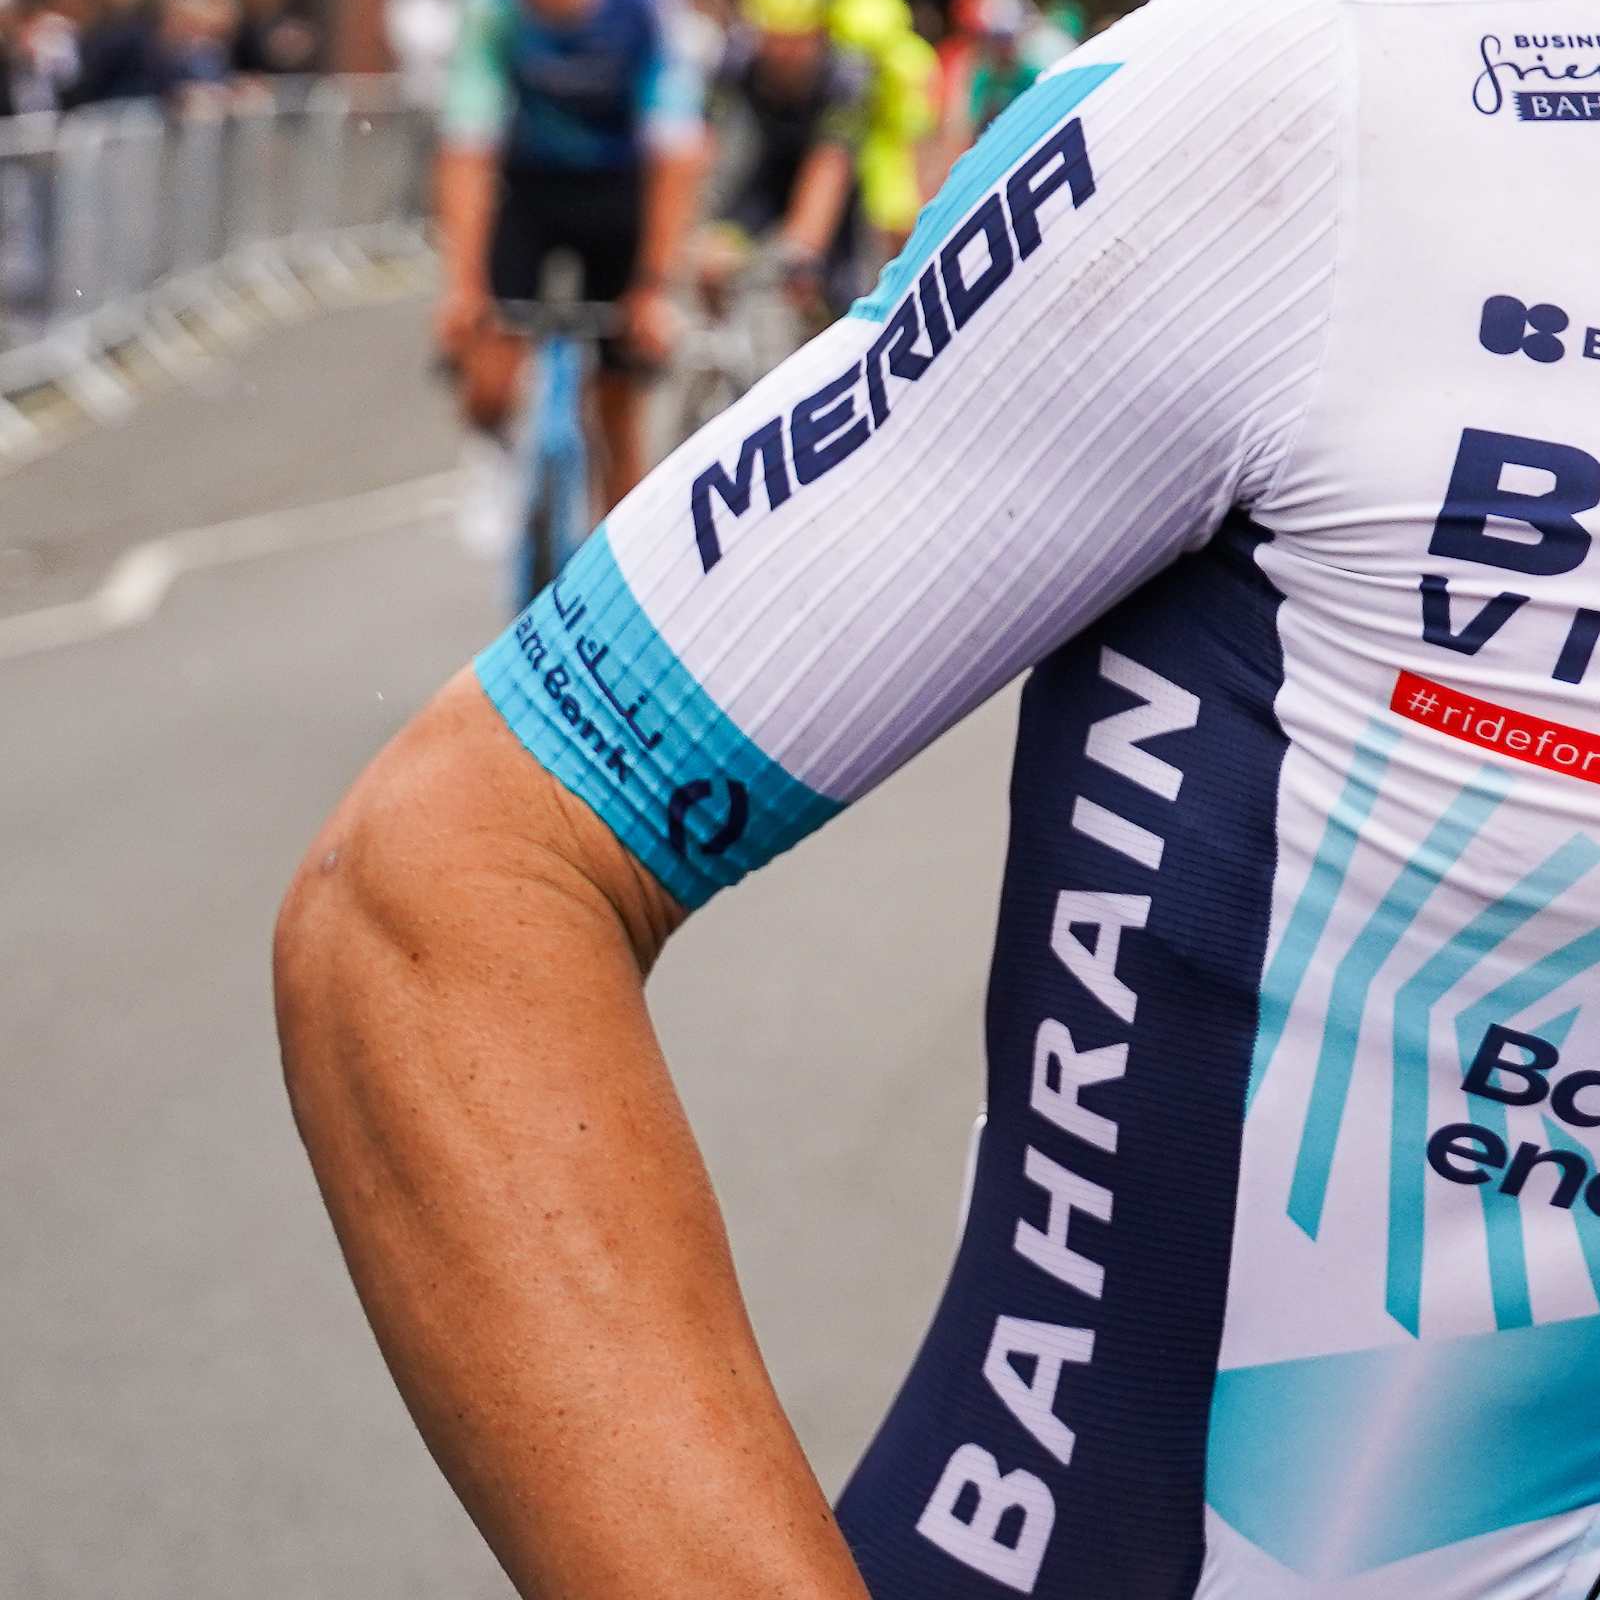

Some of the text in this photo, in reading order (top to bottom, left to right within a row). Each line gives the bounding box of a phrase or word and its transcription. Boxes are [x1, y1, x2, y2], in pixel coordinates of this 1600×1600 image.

[691, 116, 1096, 575] MERIDA
[544, 663, 627, 784] Bank
[915, 644, 1200, 1595] BAHRAIN
